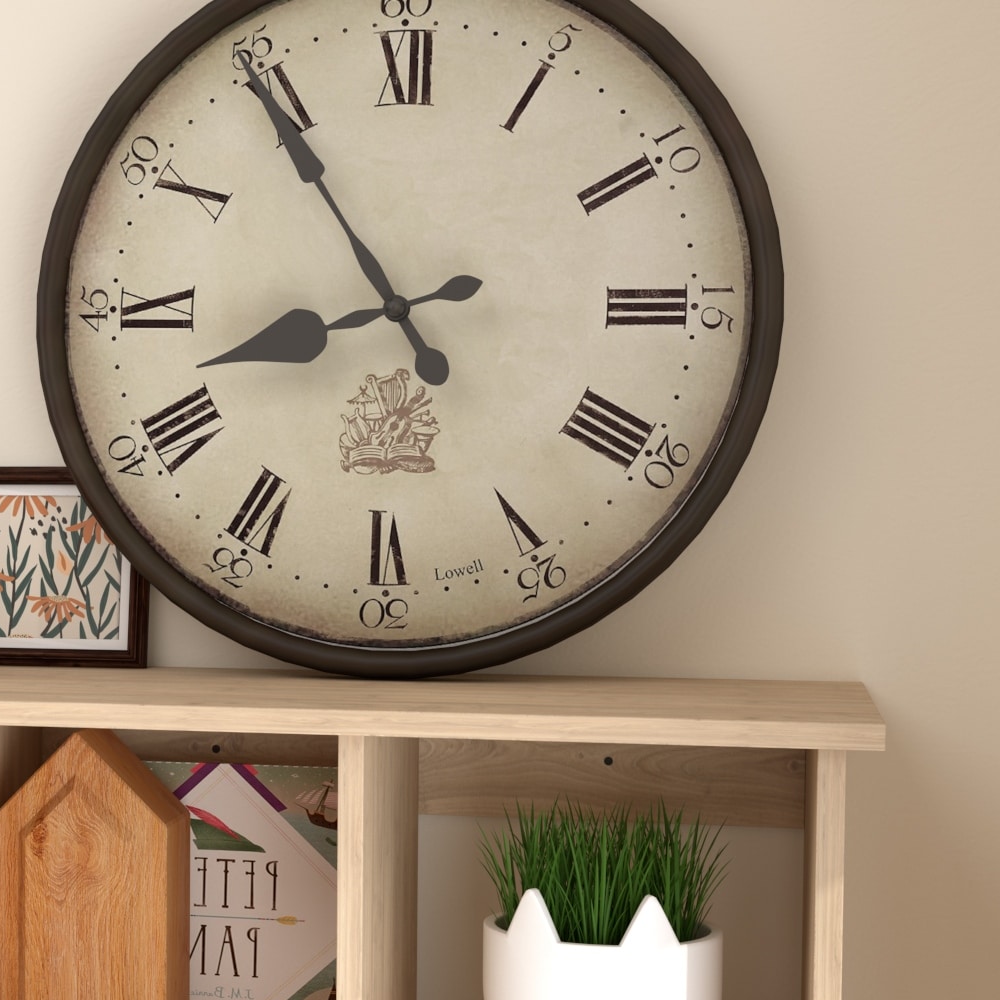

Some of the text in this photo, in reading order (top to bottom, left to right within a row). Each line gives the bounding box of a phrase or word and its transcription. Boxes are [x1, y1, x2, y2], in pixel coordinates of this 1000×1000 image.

[231, 24, 274, 70] 55
[548, 24, 582, 52] 5
[373, 30, 437, 107] XII
[119, 136, 159, 185] 50
[652, 124, 701, 173] 10
[153, 159, 233, 223] X
[577, 152, 658, 216] II
[79, 285, 109, 332] 45
[121, 285, 195, 332] IX
[605, 284, 687, 329] III
[701, 285, 735, 333] 15
[140, 382, 226, 476] VIII
[108, 435, 147, 477] 40
[644, 435, 690, 489] 20
[223, 465, 292, 558] VII
[494, 487, 548, 557] V
[202, 547, 254, 589] 35
[367, 510, 411, 586] VI
[434, 558, 485, 581] Lowell
[517, 554, 567, 604] 25
[359, 598, 409, 629] 30
